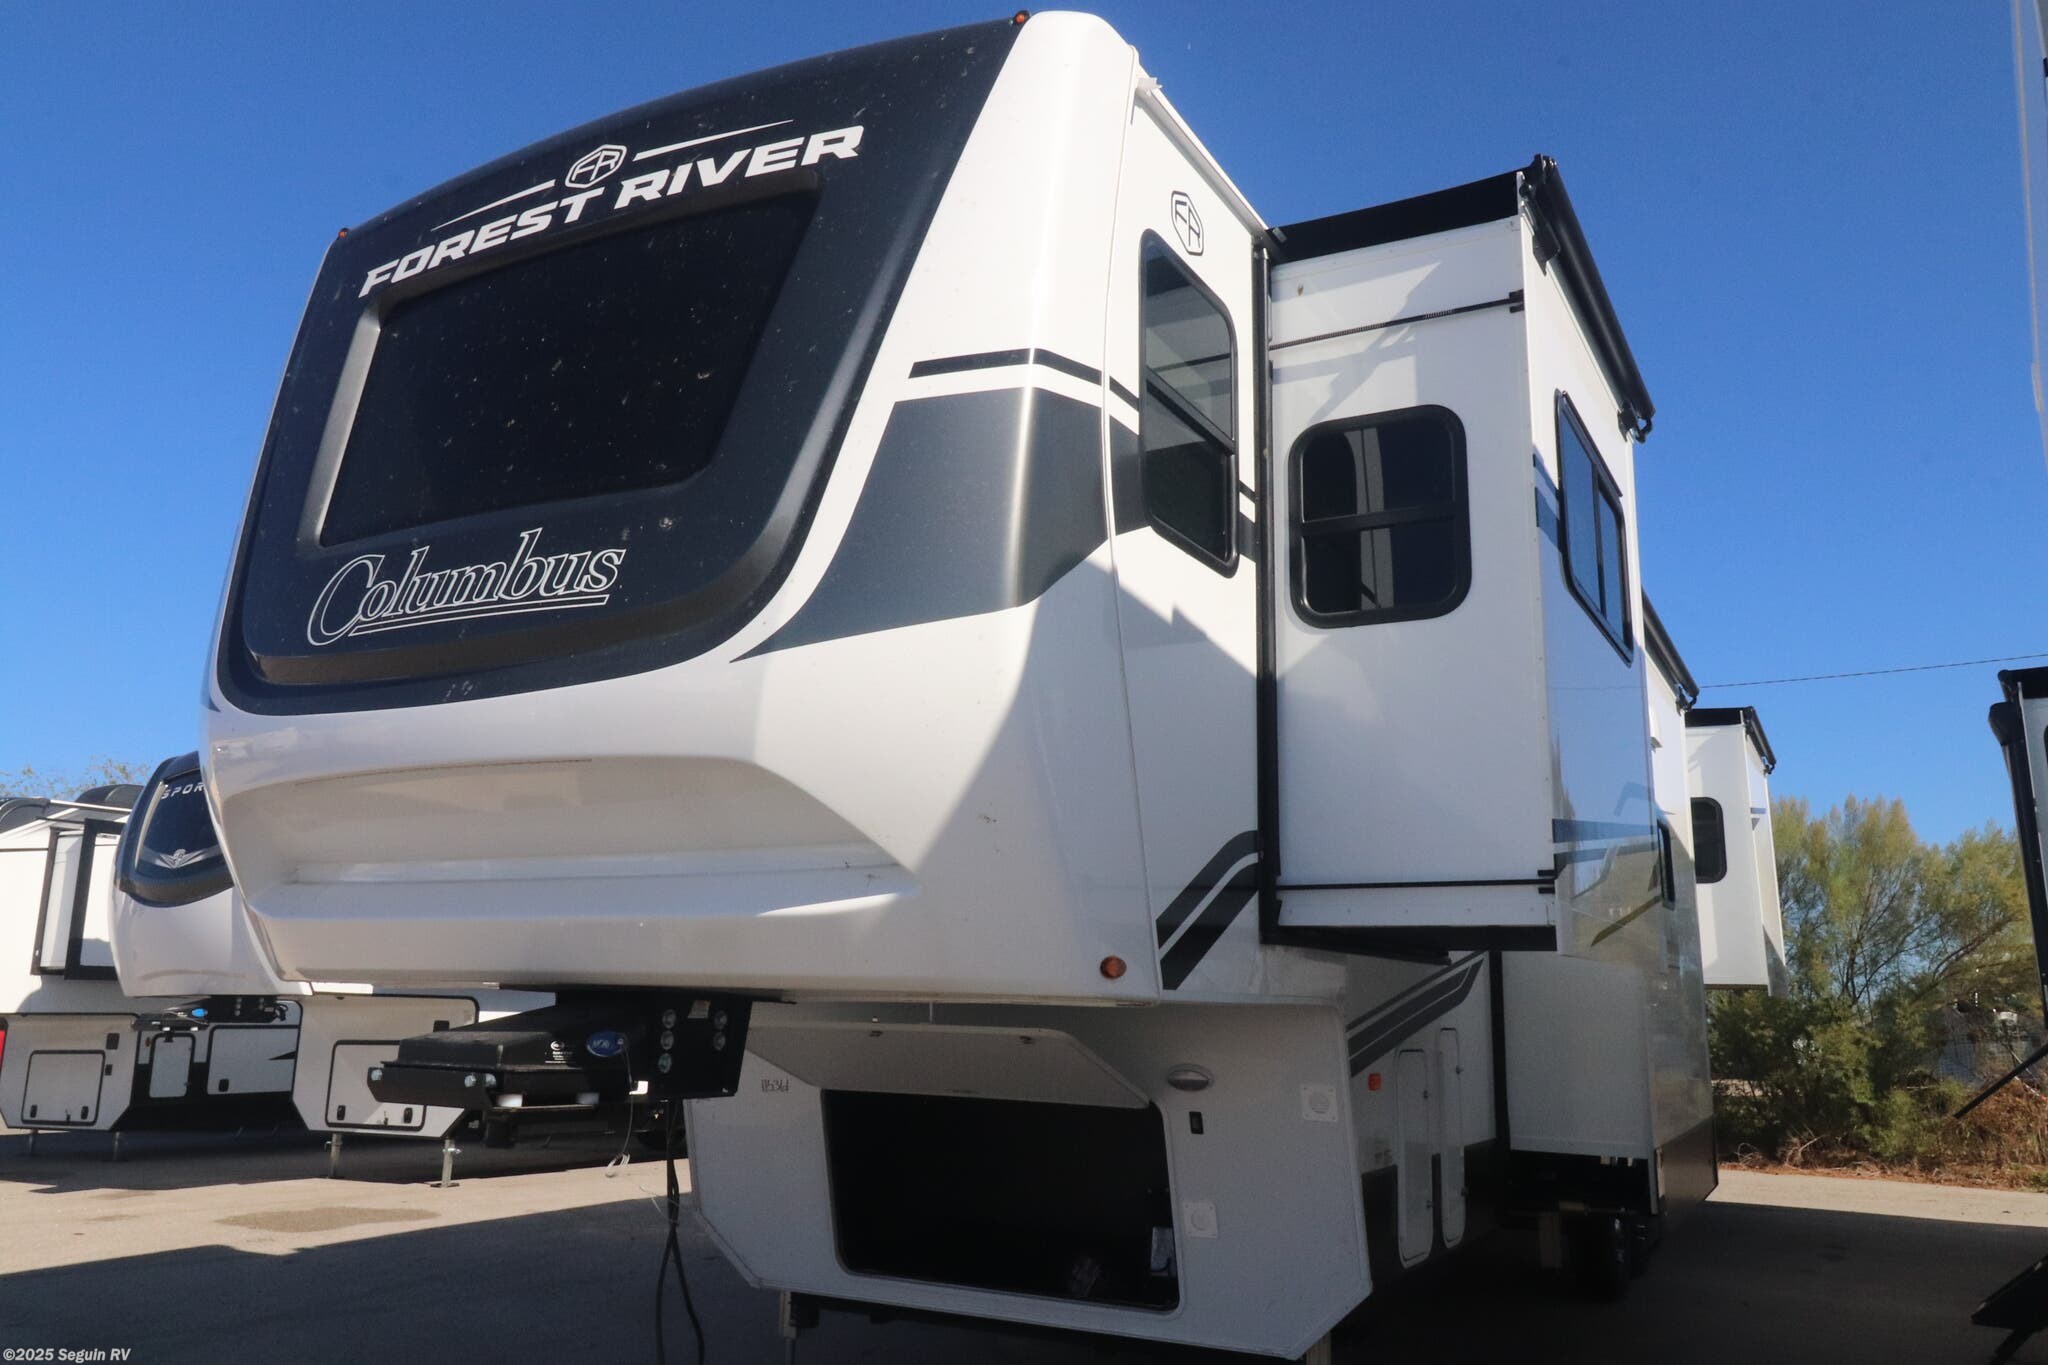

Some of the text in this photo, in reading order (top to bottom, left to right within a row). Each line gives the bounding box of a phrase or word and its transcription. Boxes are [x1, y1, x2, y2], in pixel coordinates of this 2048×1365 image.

[358, 125, 864, 298] FOREST RIVER
[307, 527, 627, 646] Columbus
